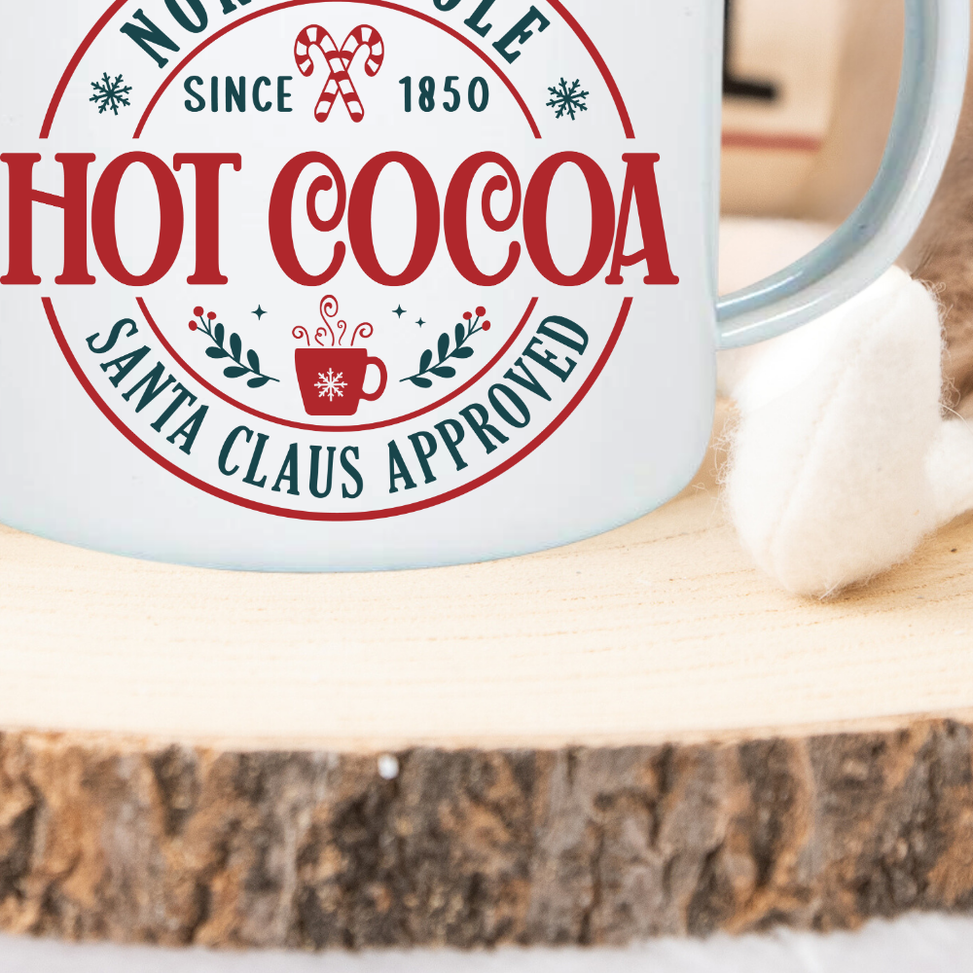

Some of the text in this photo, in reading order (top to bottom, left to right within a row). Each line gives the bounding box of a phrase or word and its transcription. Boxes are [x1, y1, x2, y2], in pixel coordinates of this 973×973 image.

[183, 75, 489, 113] SINCE 1850
[0, 151, 679, 286] HOT COCOA
[86, 315, 589, 499] SANTA CLAUS APPROVED
